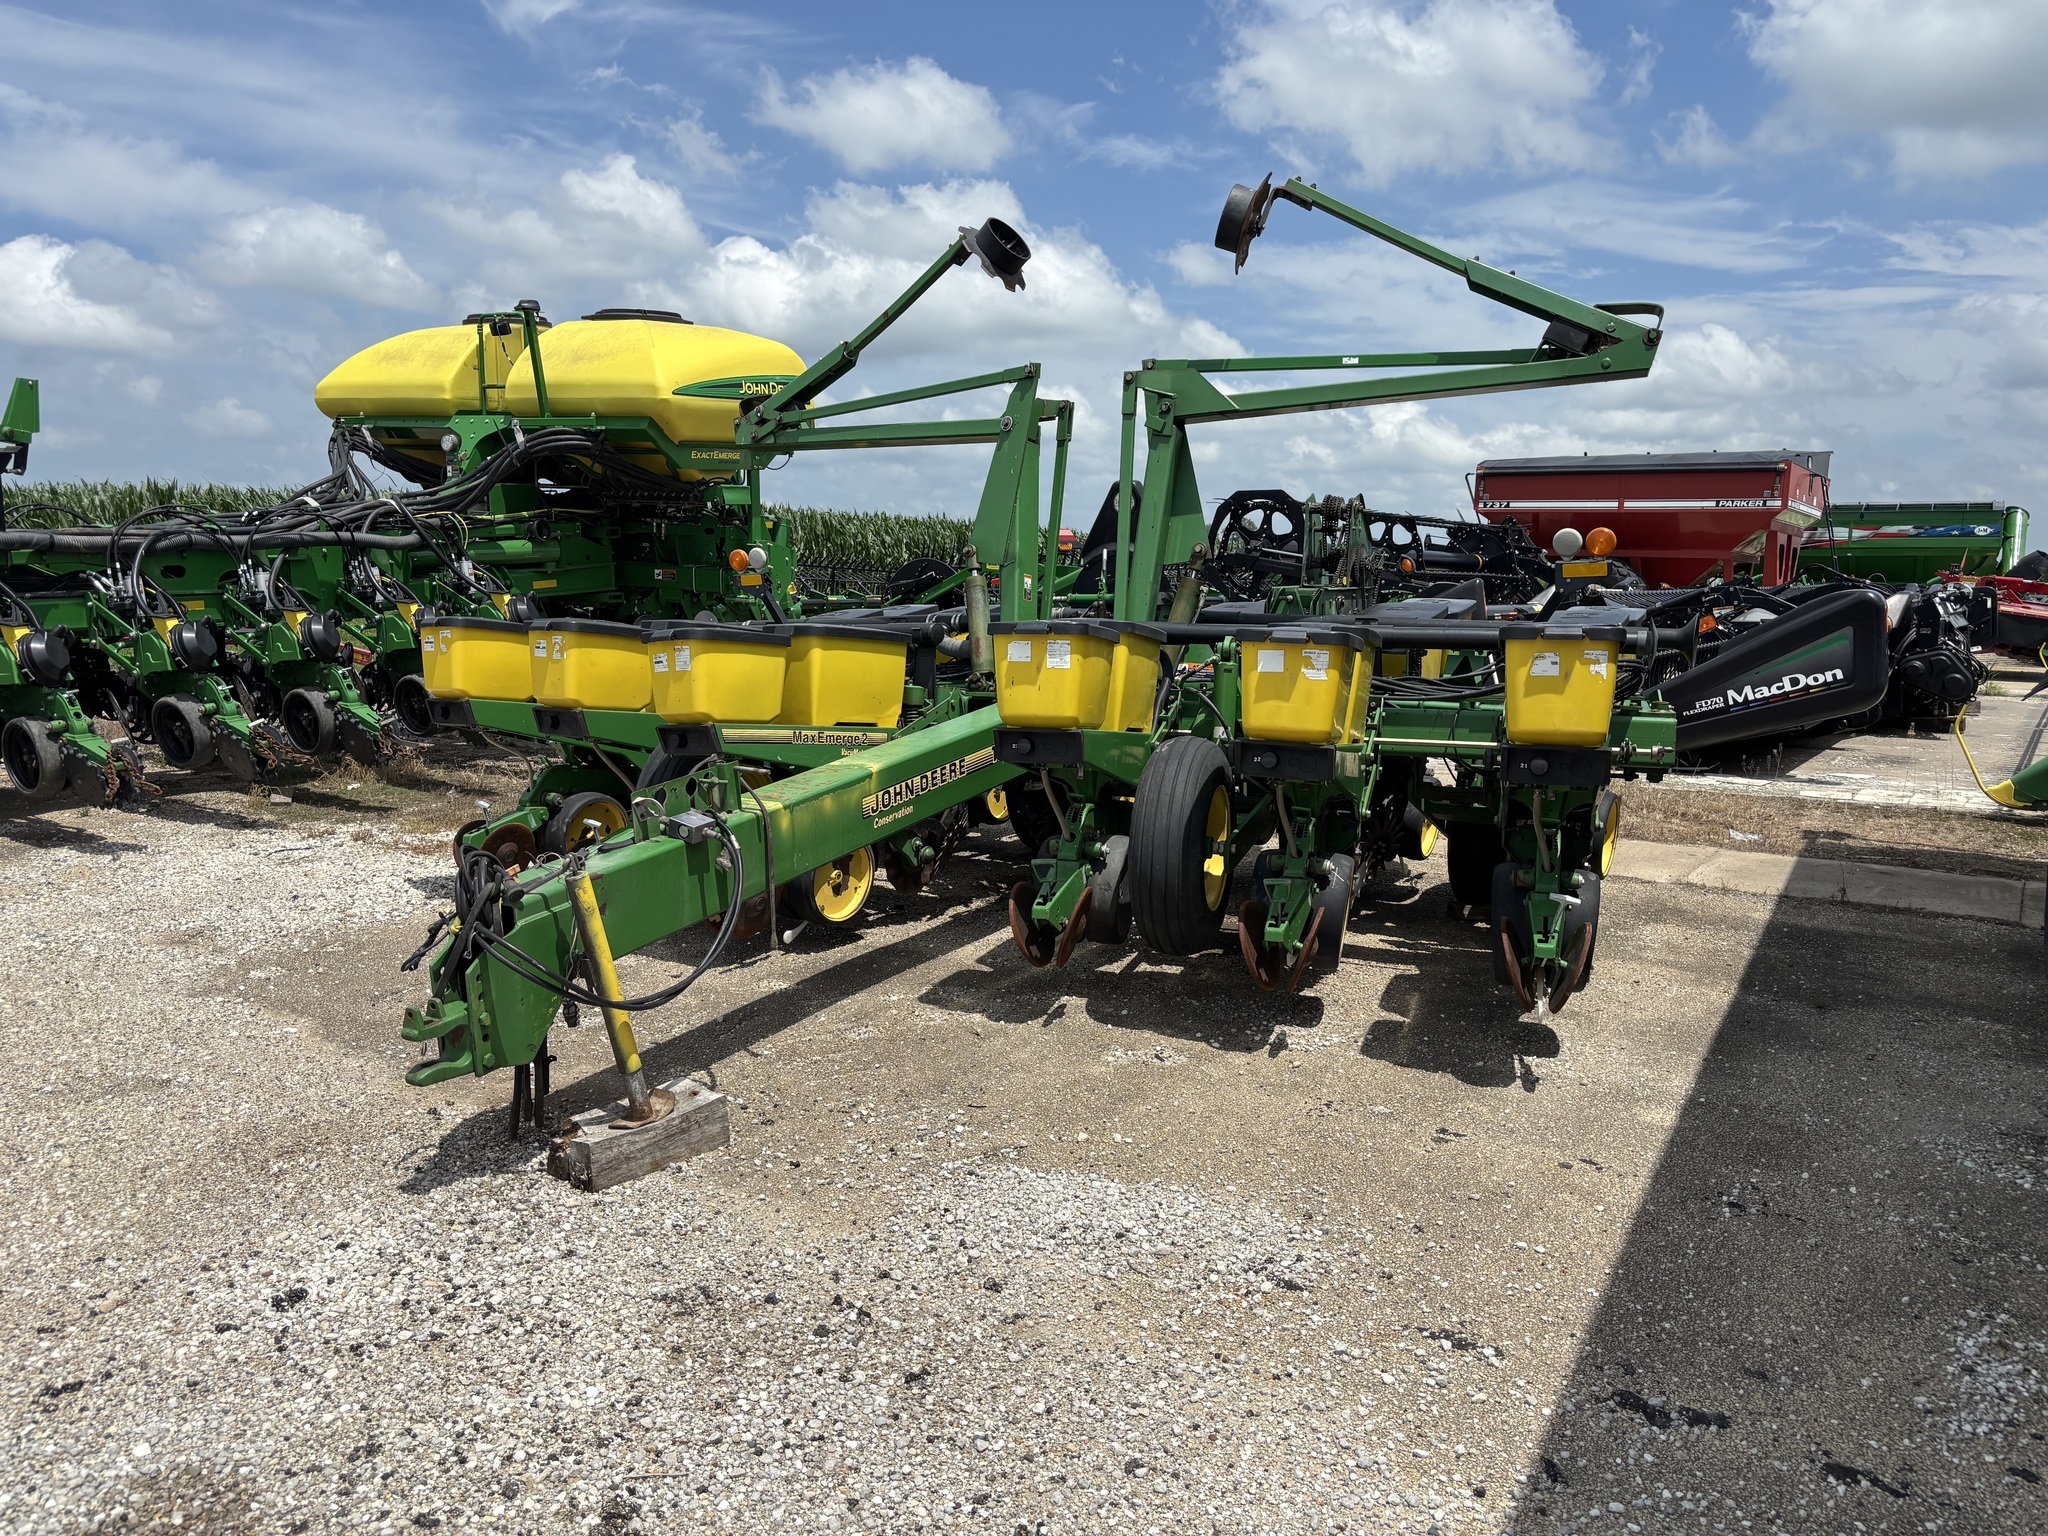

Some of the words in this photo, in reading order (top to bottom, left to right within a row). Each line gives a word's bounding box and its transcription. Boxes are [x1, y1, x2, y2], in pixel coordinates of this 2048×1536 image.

[739, 380, 769, 395] JOHN
[769, 382, 786, 395] DE
[1726, 668, 1844, 706] MacDon
[1682, 702, 1725, 717] FLEXDRAPER
[1695, 696, 1724, 709] FD70
[870, 780, 915, 816] JOHN
[919, 758, 966, 795] DEERE
[873, 805, 914, 829] Conservation
